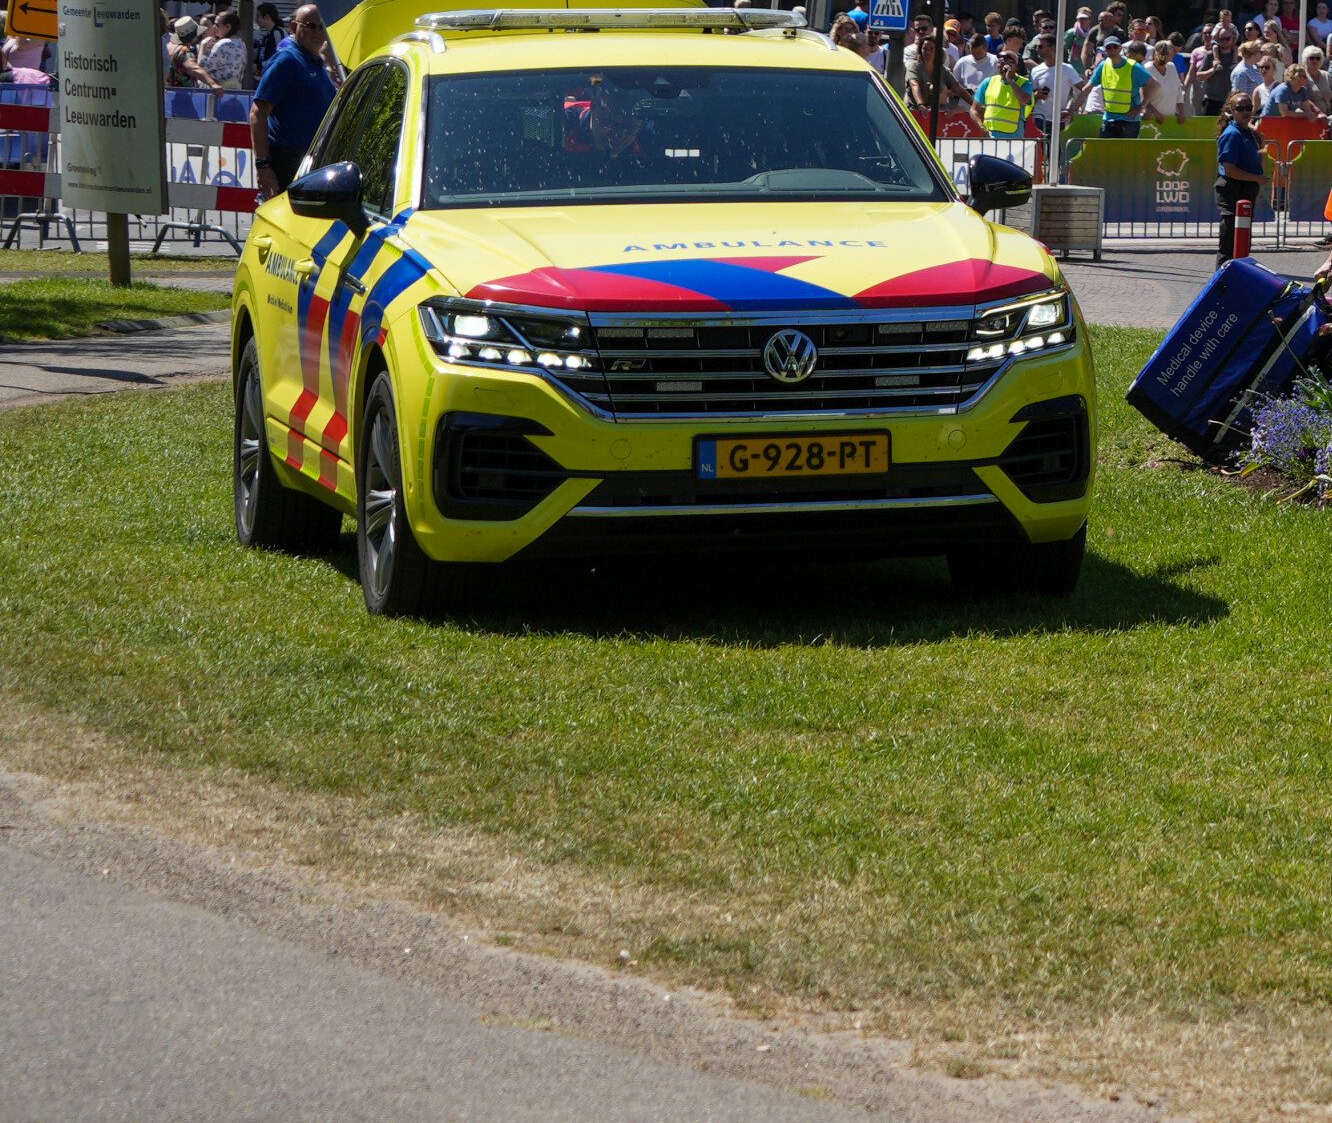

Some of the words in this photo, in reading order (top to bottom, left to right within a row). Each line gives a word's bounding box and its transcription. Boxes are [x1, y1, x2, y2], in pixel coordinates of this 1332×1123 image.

[63, 5, 91, 18] Gemeente
[94, 6, 140, 28] Leeuwarden
[64, 51, 118, 72] Historisch
[65, 106, 136, 128] Leeuwarden
[1156, 180, 1190, 191] LOOP
[1156, 191, 1190, 203] LWD
[622, 239, 889, 253] AMBULANCE
[1156, 342, 1193, 386] Medical
[1189, 309, 1218, 345] device
[1169, 360, 1203, 397] handle
[1199, 337, 1220, 361] with
[1217, 313, 1239, 338] care
[729, 440, 877, 472] G-928-PT
[701, 464, 715, 473] NL
